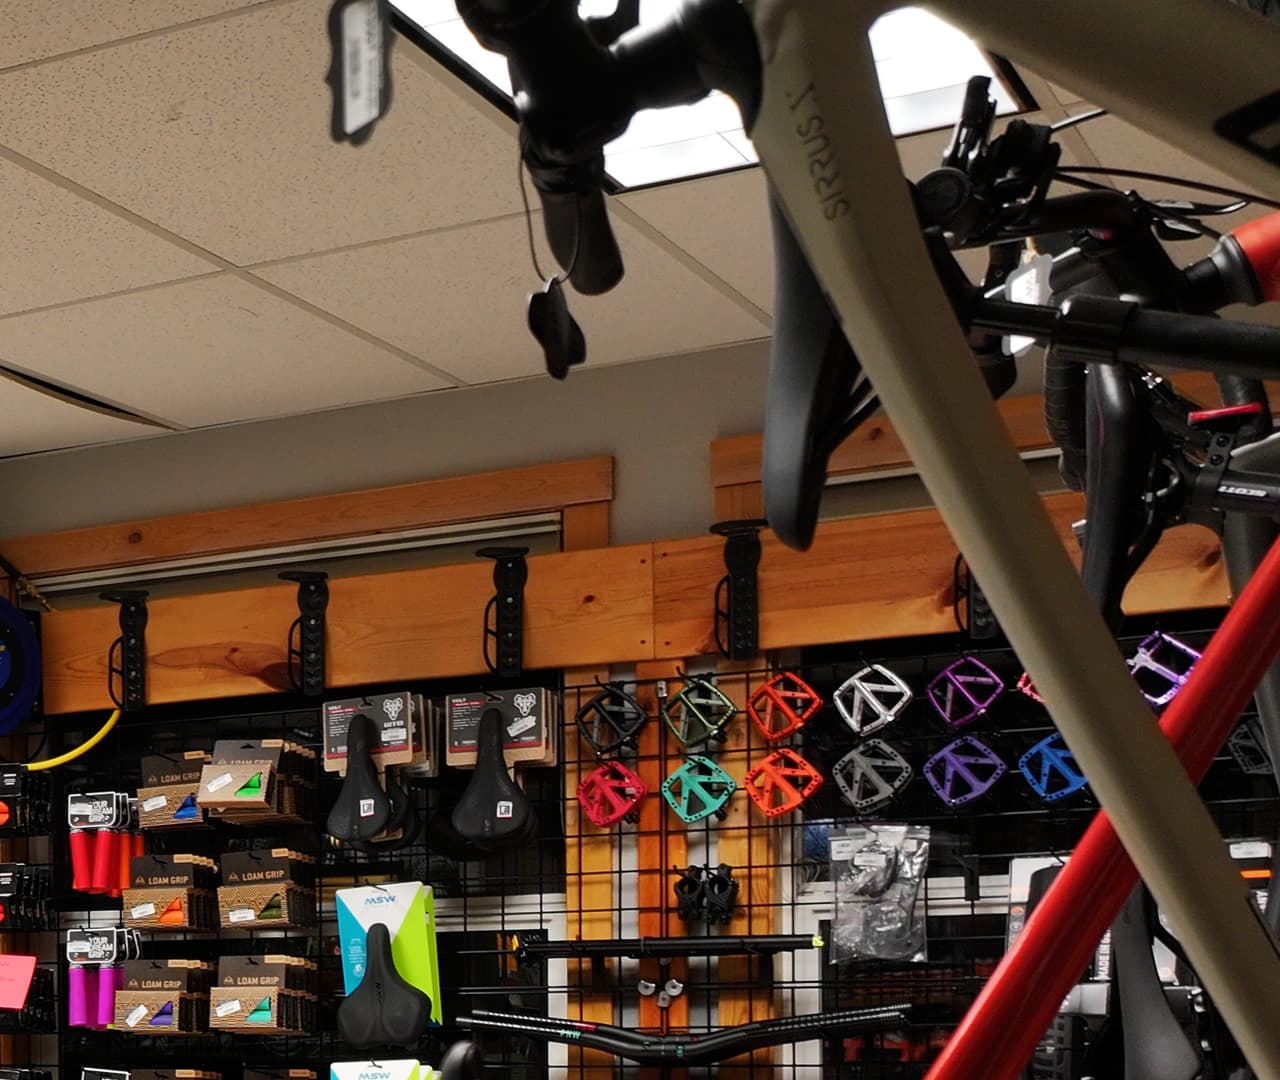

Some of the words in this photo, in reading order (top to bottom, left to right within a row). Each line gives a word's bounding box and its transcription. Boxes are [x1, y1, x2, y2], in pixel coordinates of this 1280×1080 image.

[160, 773, 181, 783] LOAM
[181, 771, 201, 782] GRIP
[242, 871, 264, 881] LOAM
[265, 869, 286, 880] GRIP
[148, 876, 170, 886] LOAM
[170, 875, 190, 885] GRIP
[364, 895, 397, 905] MSW
[88, 936, 109, 945] YOUR
[141, 979, 163, 989] LOAM
[163, 979, 183, 989] GRIP
[237, 976, 260, 986] LOAM
[259, 975, 281, 986] GRIP
[357, 1071, 391, 1080] MSW
